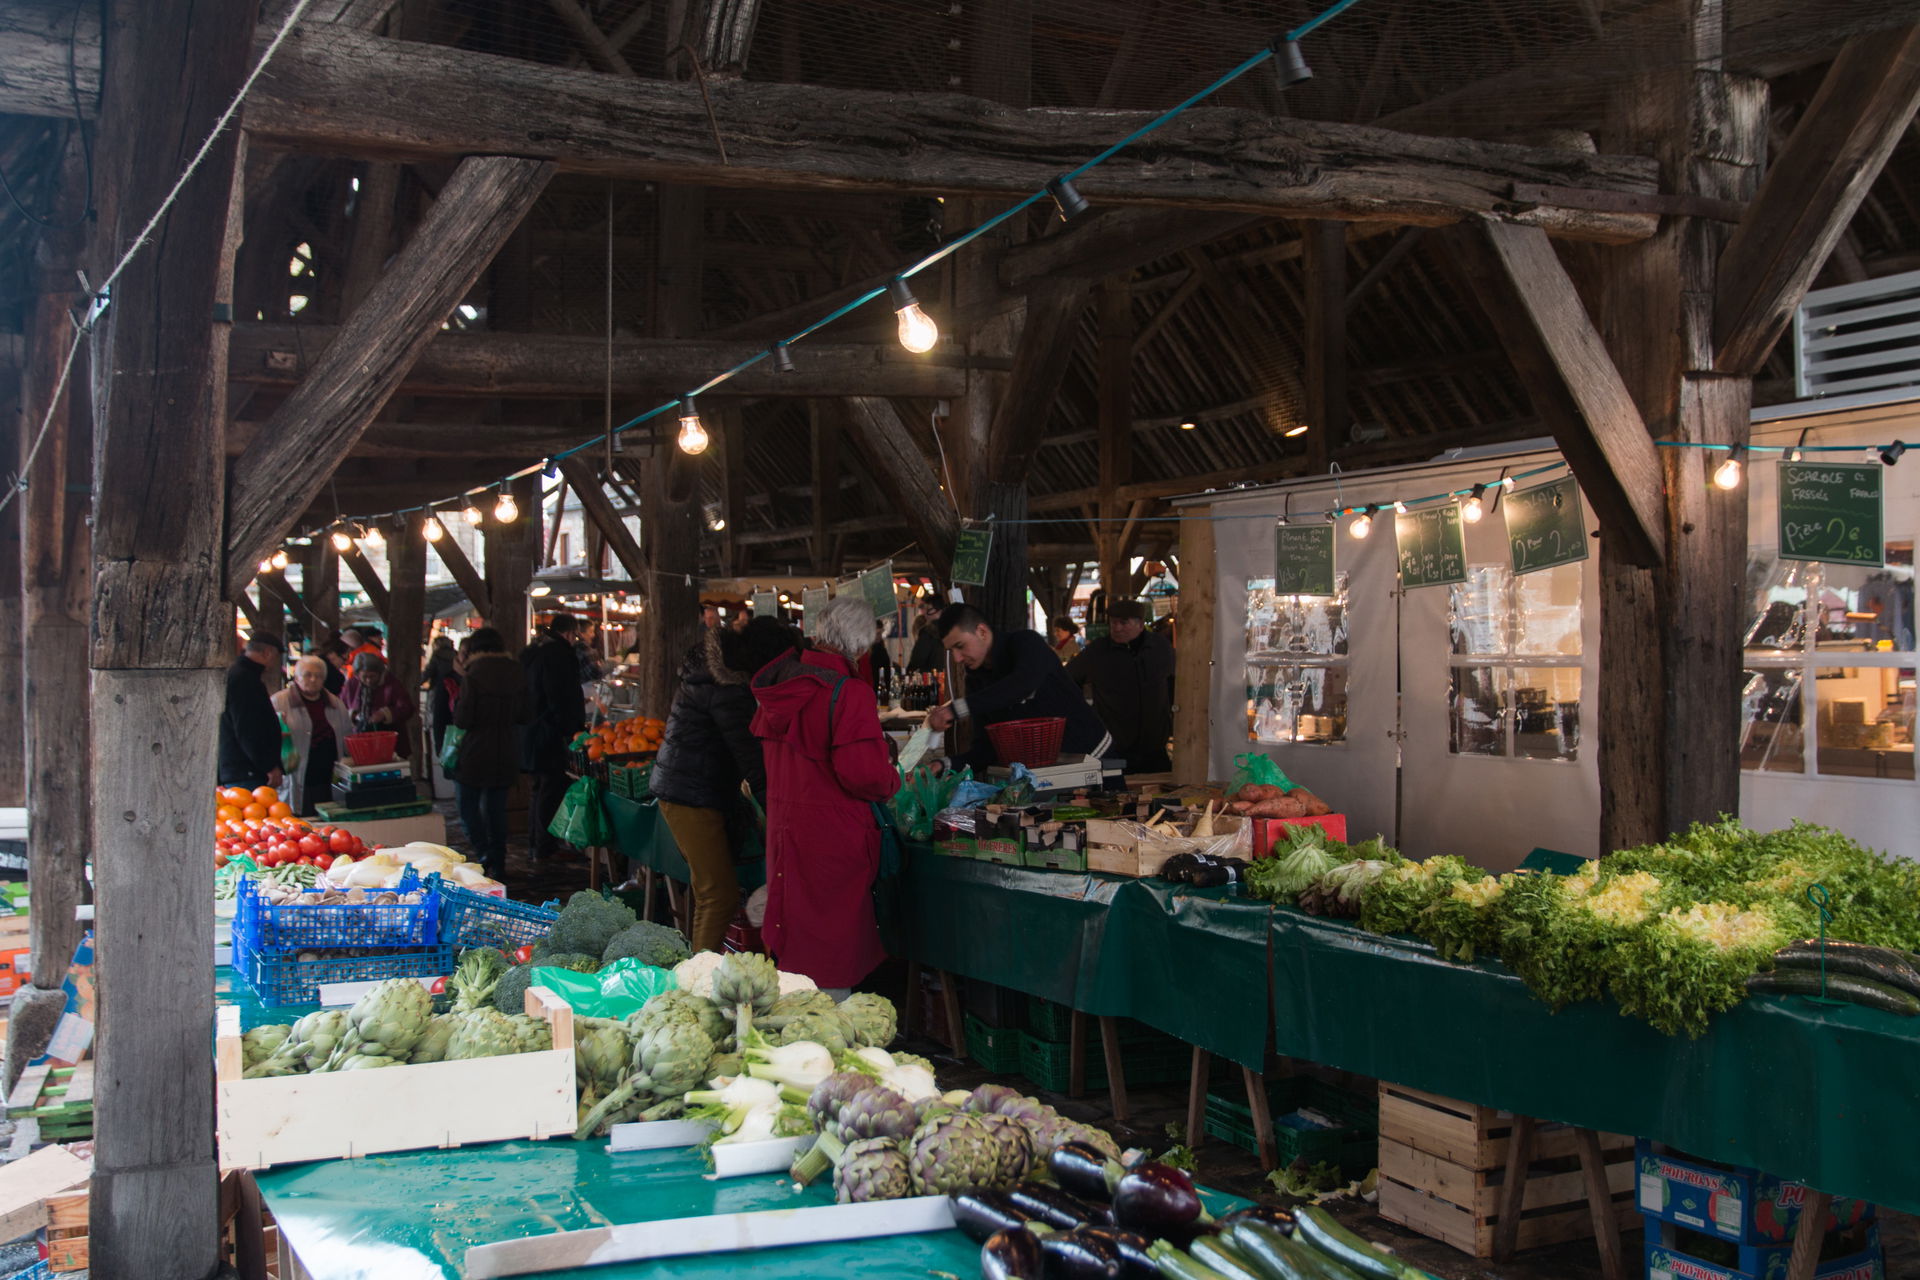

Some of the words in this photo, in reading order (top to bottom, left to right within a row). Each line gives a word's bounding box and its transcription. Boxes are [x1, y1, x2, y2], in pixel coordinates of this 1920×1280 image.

[1786, 467, 1846, 485] SCAROLE
[1515, 539, 1534, 570] 2
[1659, 1163, 1720, 1190] POIVRONS
